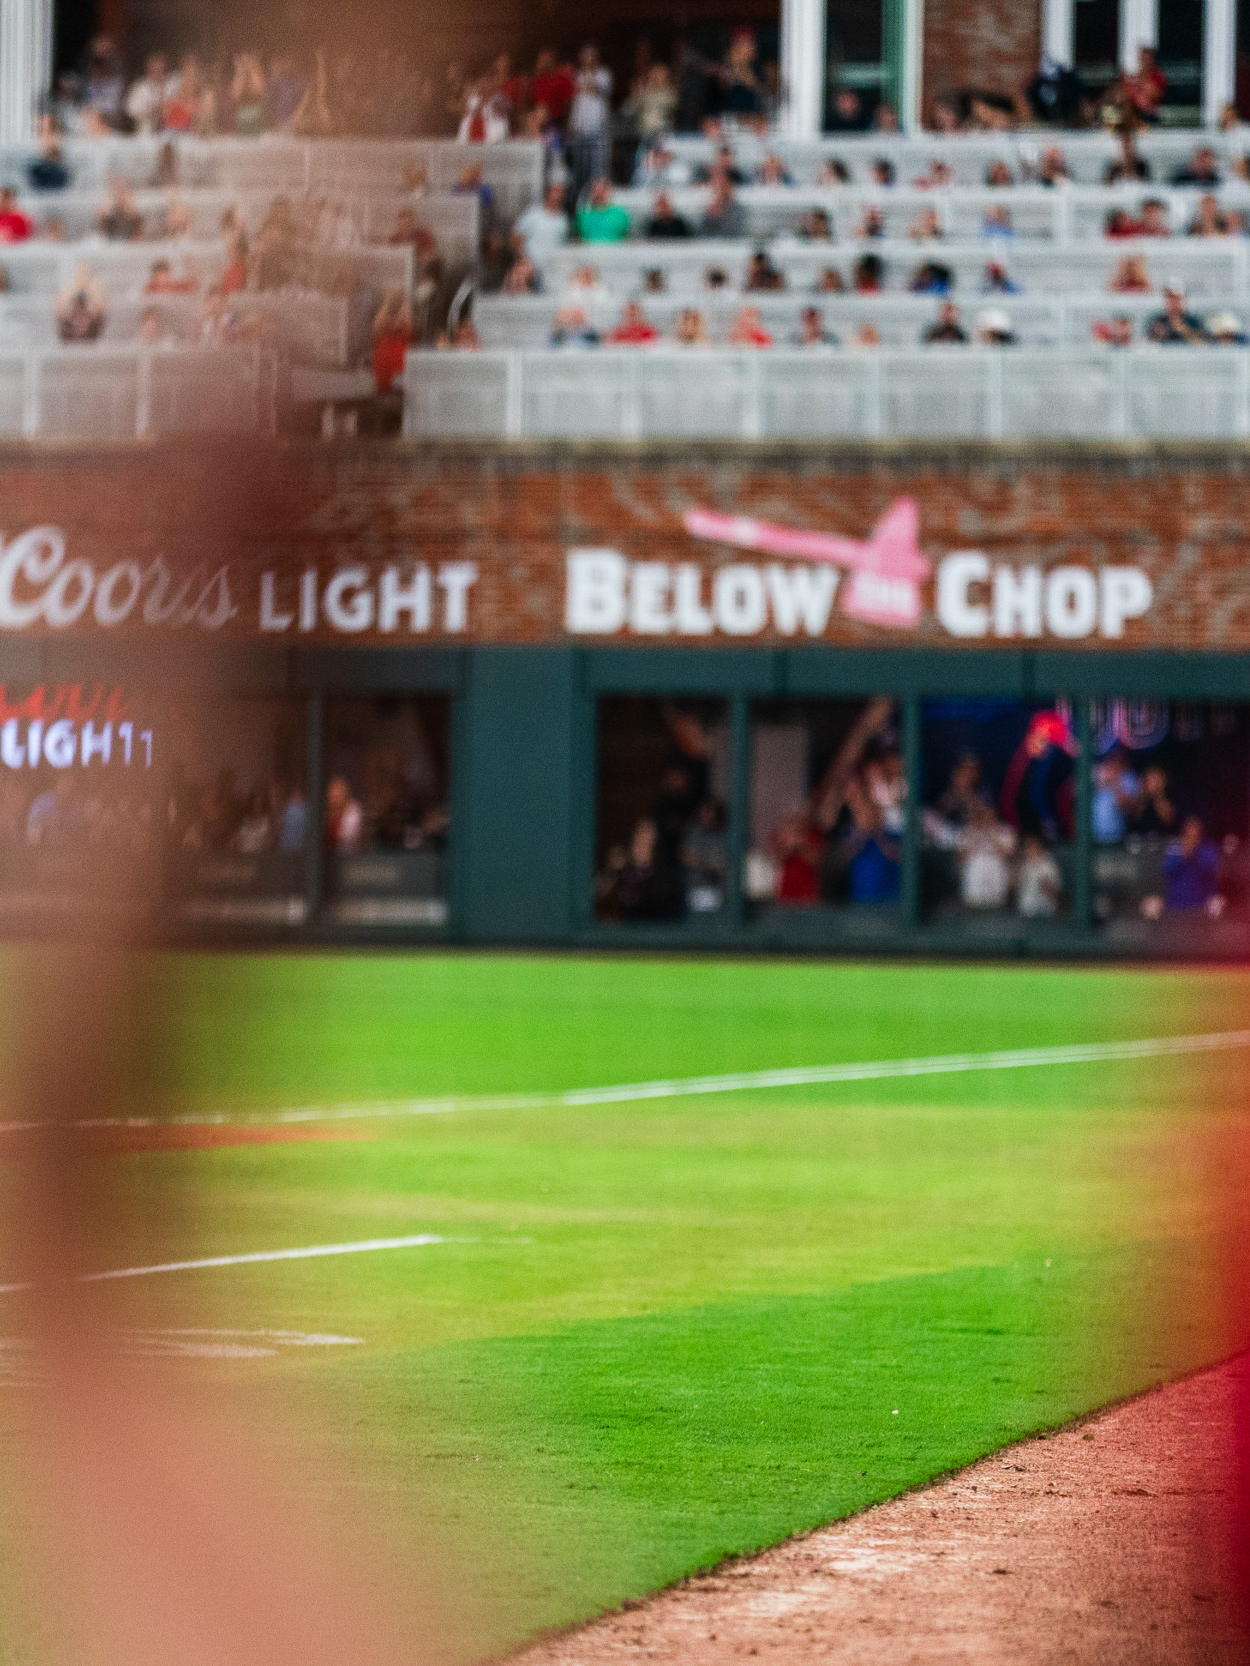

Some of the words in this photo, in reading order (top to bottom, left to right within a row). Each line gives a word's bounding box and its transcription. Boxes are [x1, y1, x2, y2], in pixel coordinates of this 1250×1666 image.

[259, 560, 479, 634] LIGHT
[564, 547, 841, 638] BELOW
[936, 549, 1153, 640] CHOP
